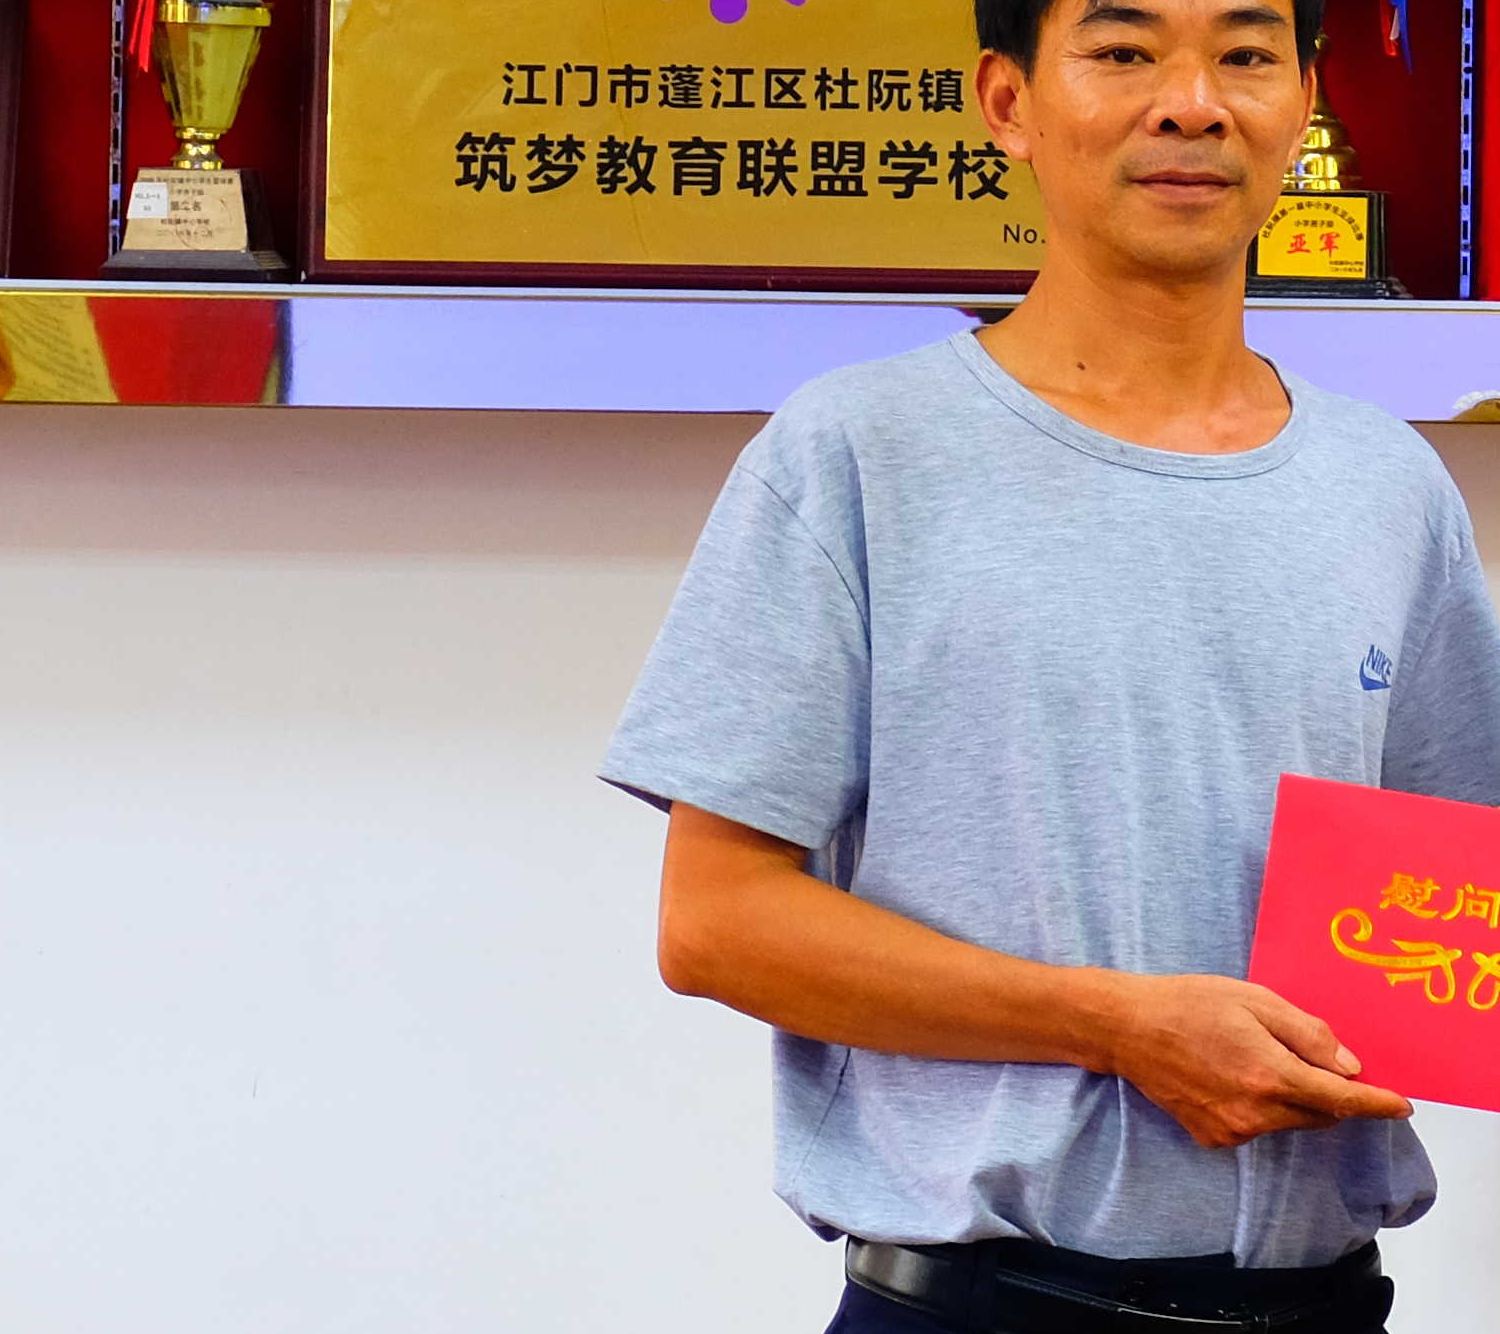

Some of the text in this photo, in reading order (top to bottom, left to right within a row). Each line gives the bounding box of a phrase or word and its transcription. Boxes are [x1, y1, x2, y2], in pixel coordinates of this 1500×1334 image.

[501, 63, 964, 114] 江门市蓬江区杜阮镇
[454, 132, 1010, 201] 筑梦教育联盟学校
[1003, 224, 1046, 245] No.
[1366, 644, 1392, 684] NIKE
